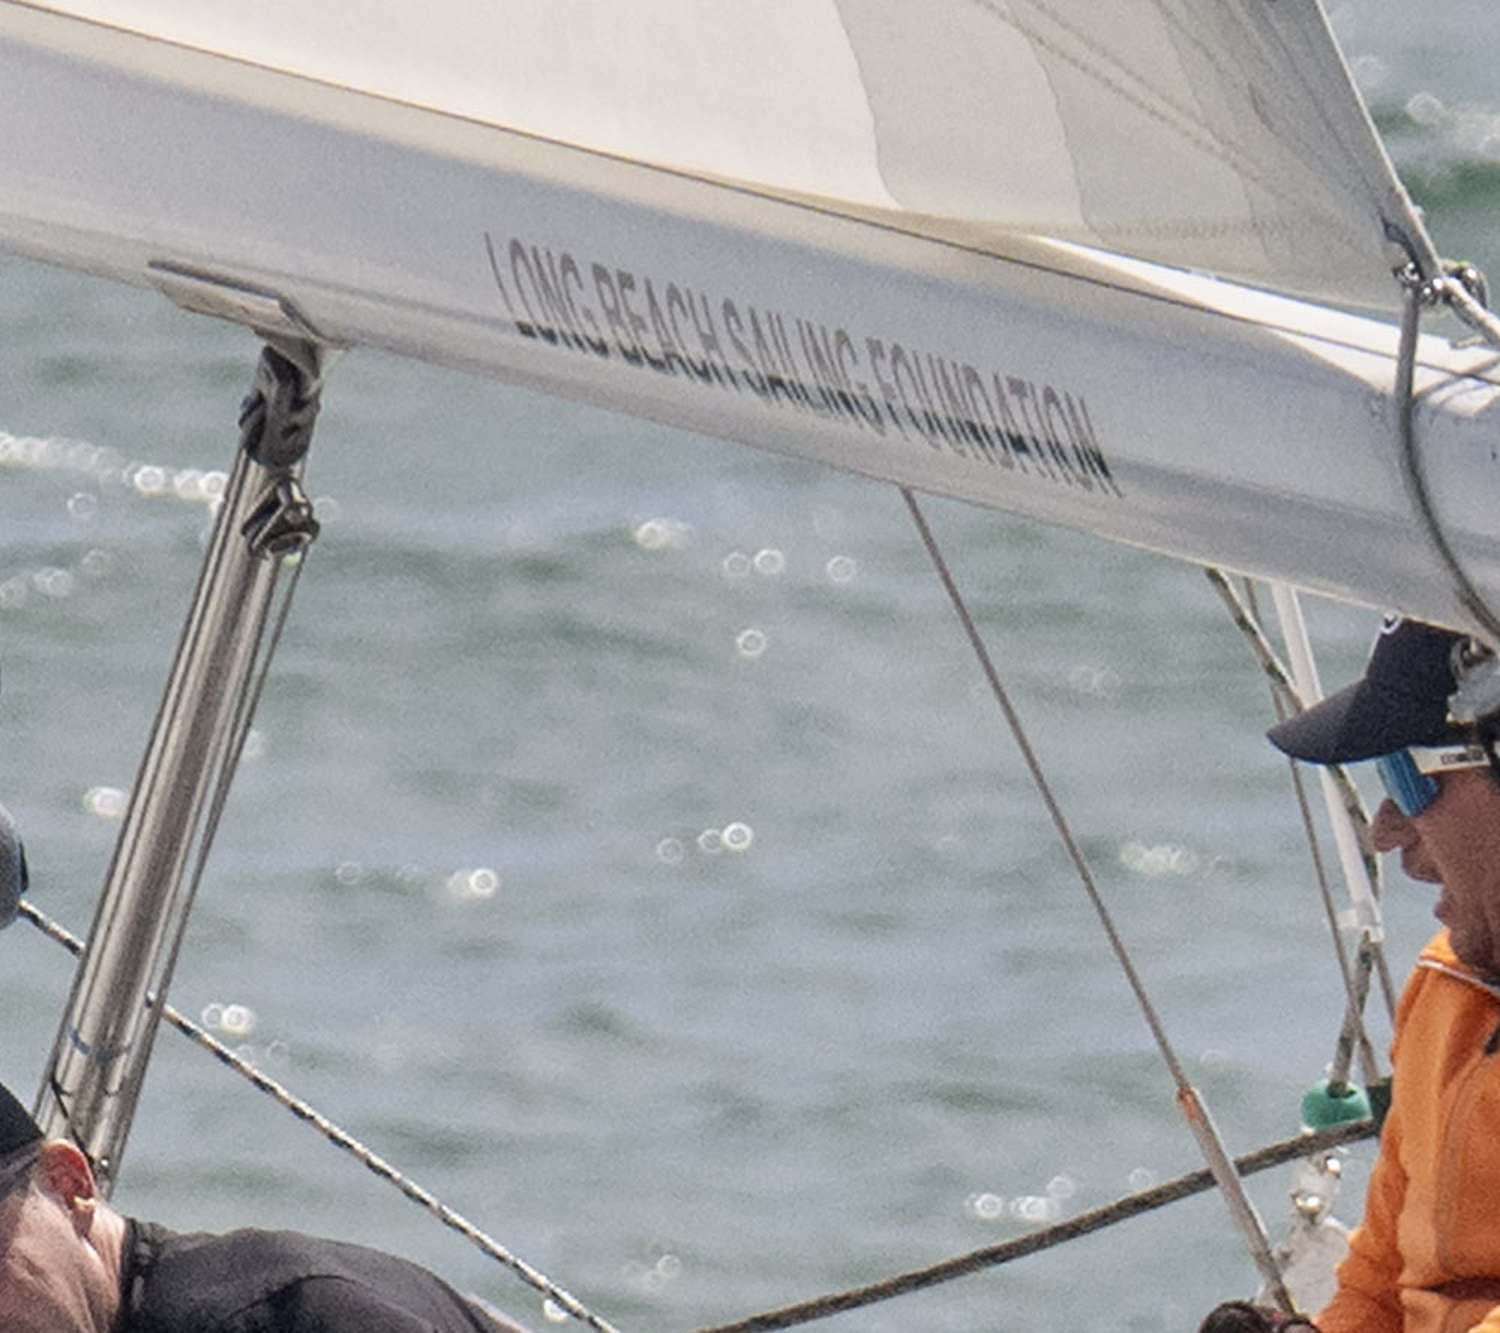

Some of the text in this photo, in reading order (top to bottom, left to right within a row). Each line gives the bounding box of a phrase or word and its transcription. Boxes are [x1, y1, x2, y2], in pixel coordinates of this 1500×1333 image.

[485, 231, 1123, 499] LONG BEACH SAILING FOUNDATION
